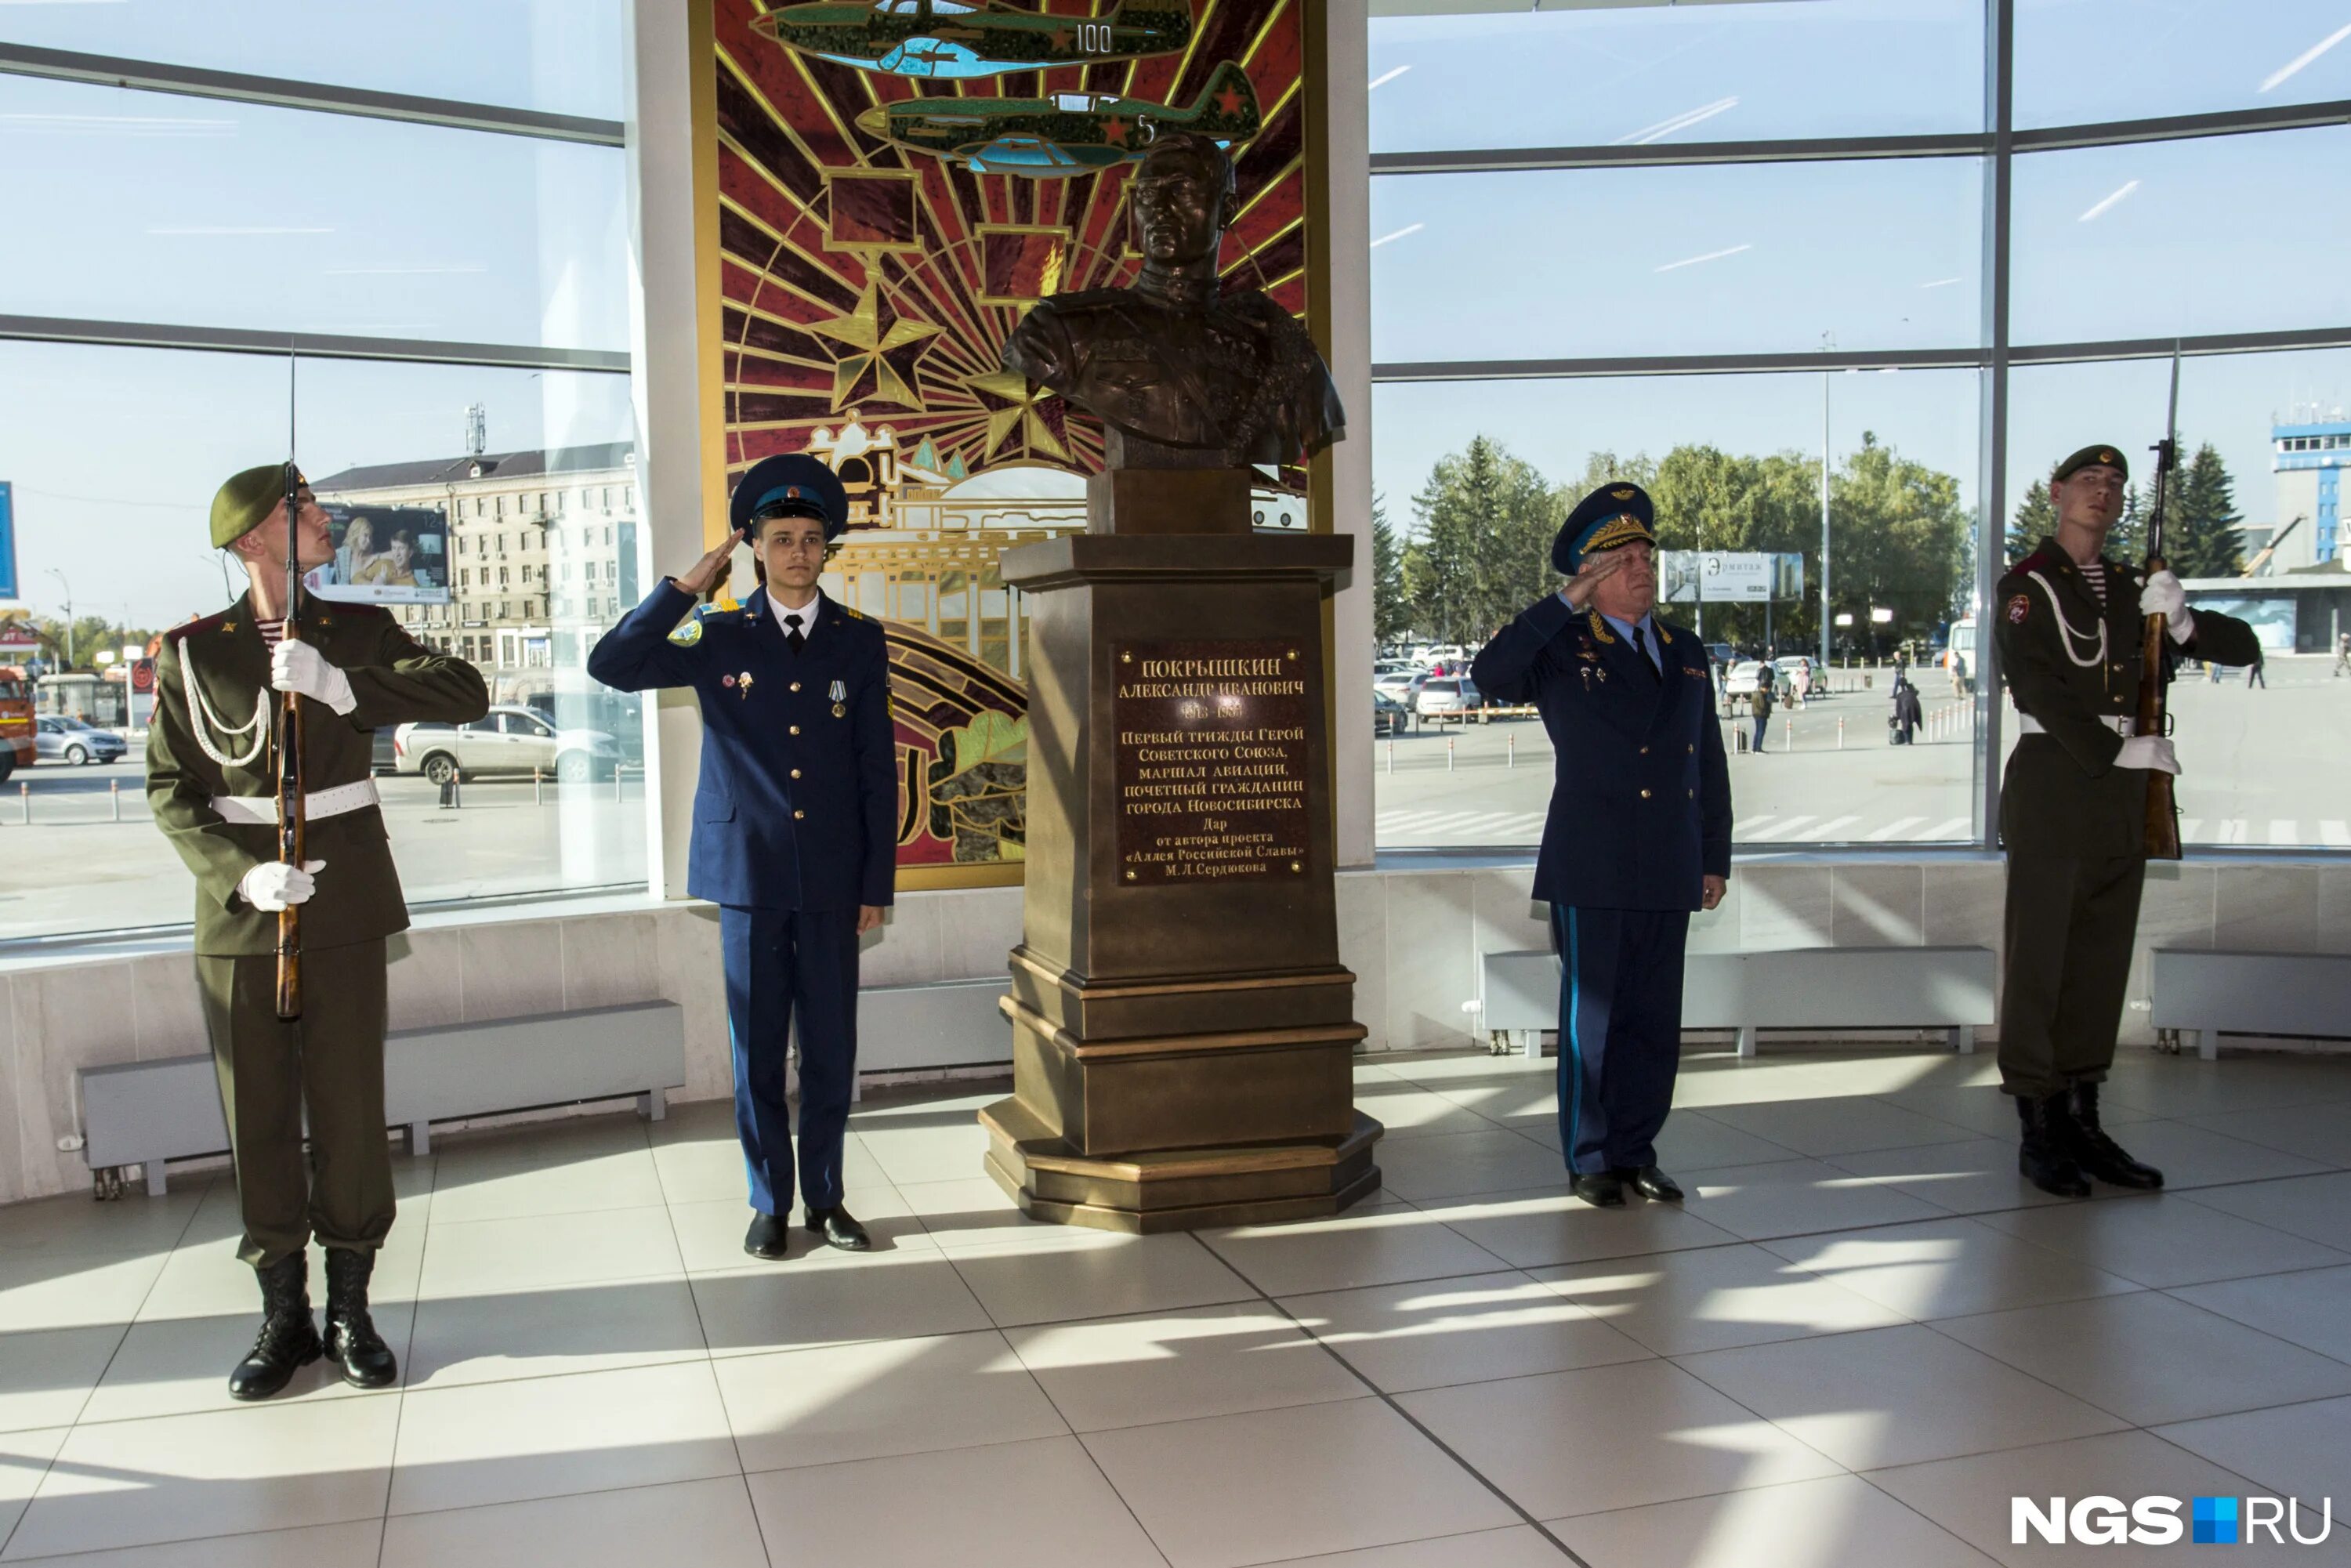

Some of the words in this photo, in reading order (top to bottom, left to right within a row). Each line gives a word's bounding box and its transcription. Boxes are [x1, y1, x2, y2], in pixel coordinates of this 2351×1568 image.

[1078, 24, 1110, 53] 100
[1139, 114, 1154, 144] 5
[422, 514, 444, 528] 12+
[1708, 557, 1762, 576] Эрмитаж
[1141, 658, 1281, 678] ПОКРЫШКИН
[1119, 683, 1214, 698] АЛЕКСАНДР
[1219, 681, 1304, 696] ИВАНОВИЧ
[1203, 818, 1227, 832] Дар
[1157, 835, 1172, 846] от
[1175, 835, 1219, 847] автора
[1223, 832, 1273, 845] проекта
[1126, 850, 1174, 863] «Аллея
[1179, 846, 1252, 861] Российской
[1256, 845, 1304, 857] Славы»
